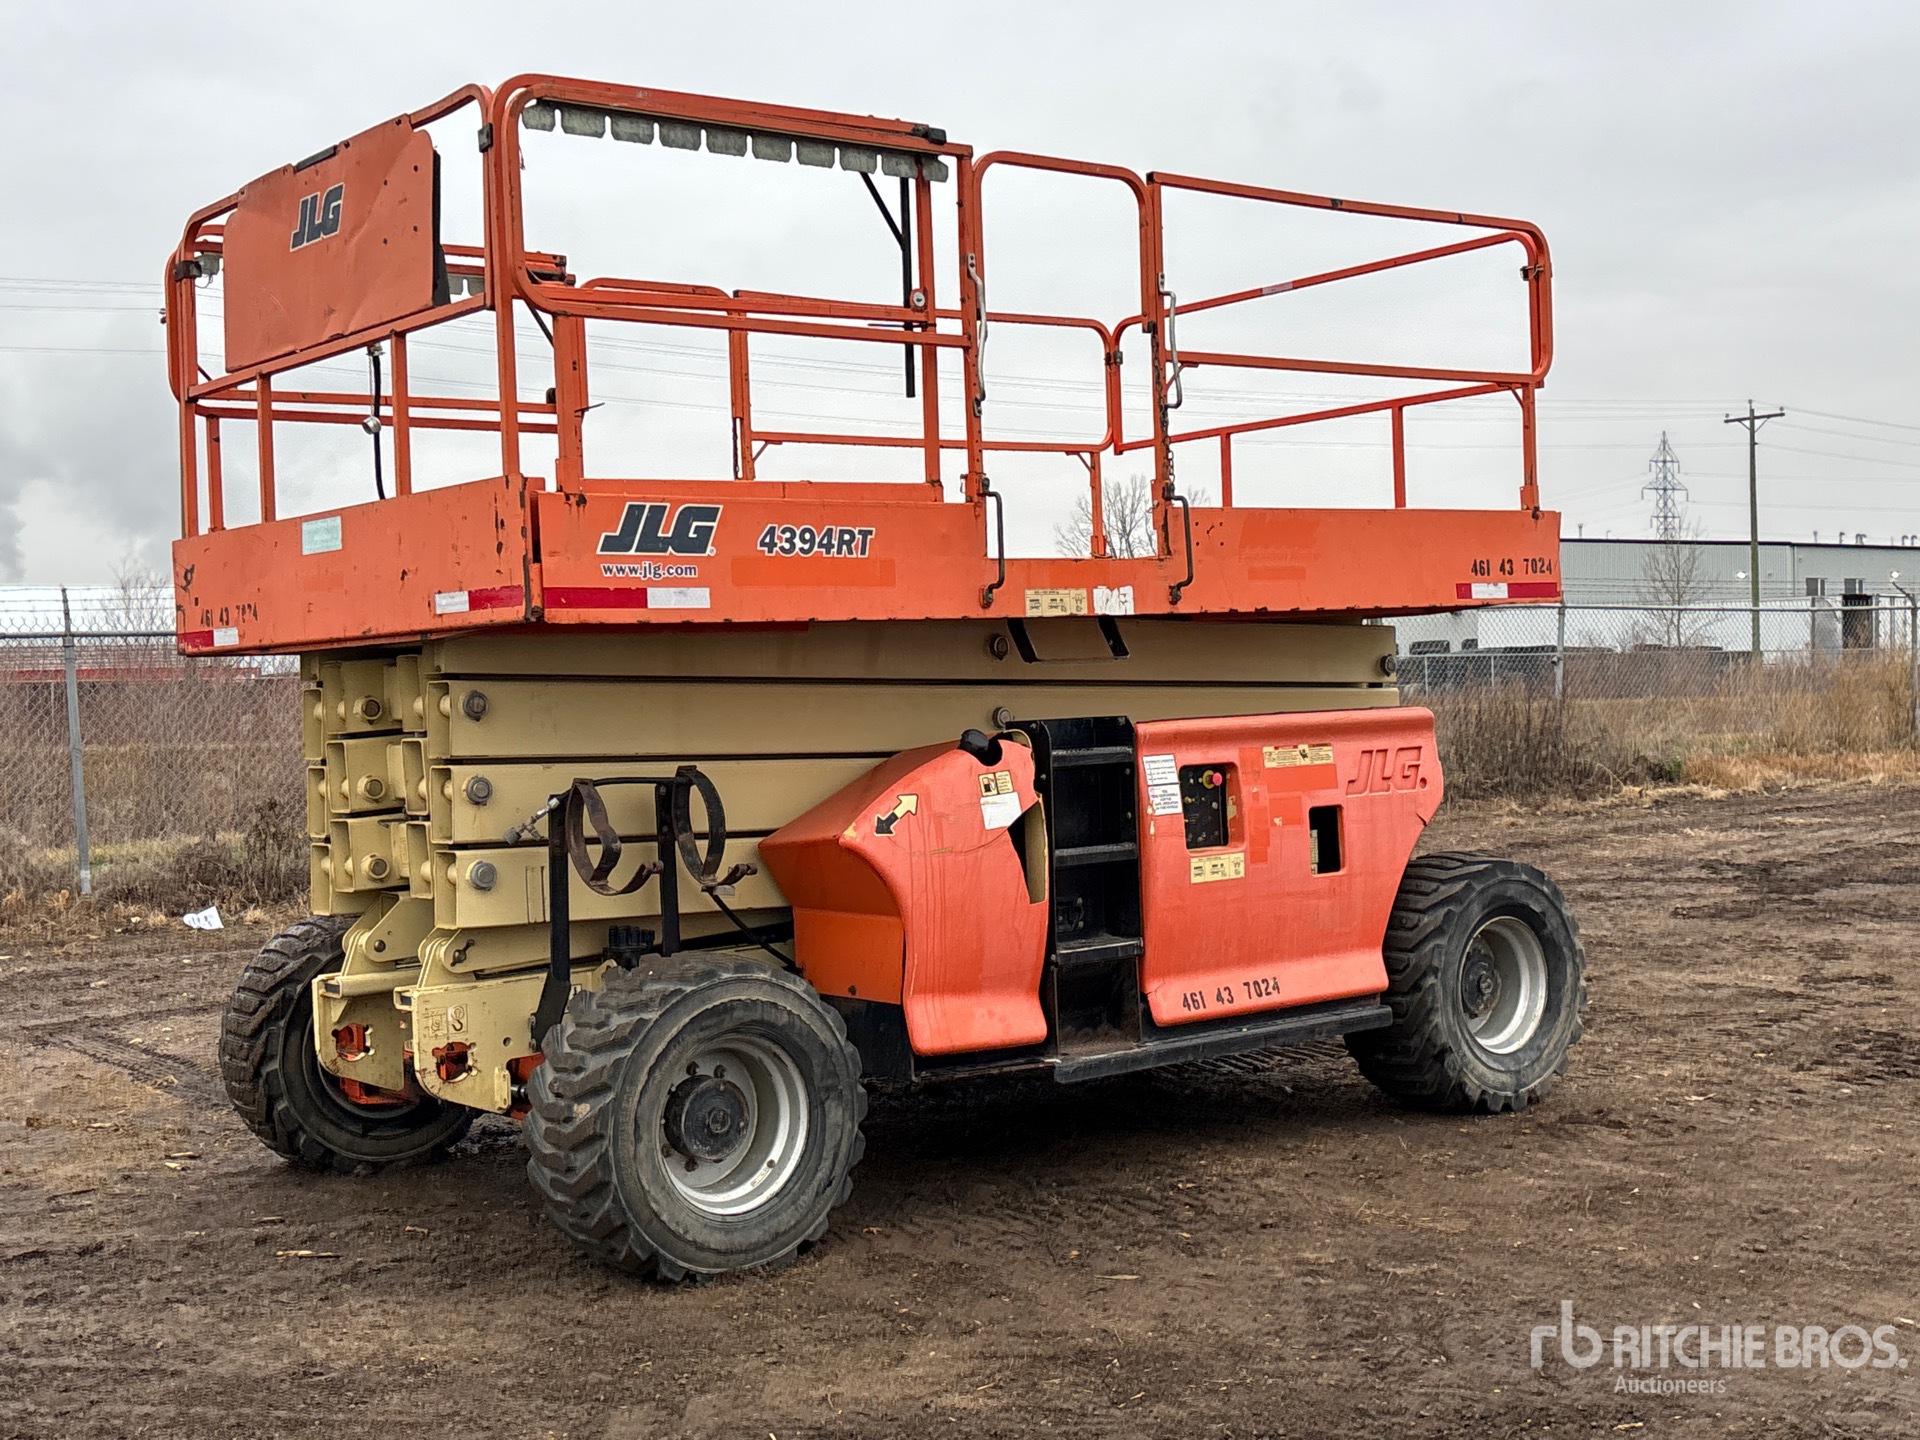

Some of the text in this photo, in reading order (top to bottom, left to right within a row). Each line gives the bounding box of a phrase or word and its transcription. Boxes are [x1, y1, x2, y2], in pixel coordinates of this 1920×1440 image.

[290, 182, 344, 252] JLG
[597, 502, 723, 555] JLG
[757, 524, 875, 558] 4394RT
[600, 562, 698, 580] www.jlg.com
[1470, 557, 1552, 577] 461 43 7024
[219, 606, 230, 626] 43
[1346, 746, 1422, 797] JLG
[1182, 976, 1281, 1012] 461 43 7024
